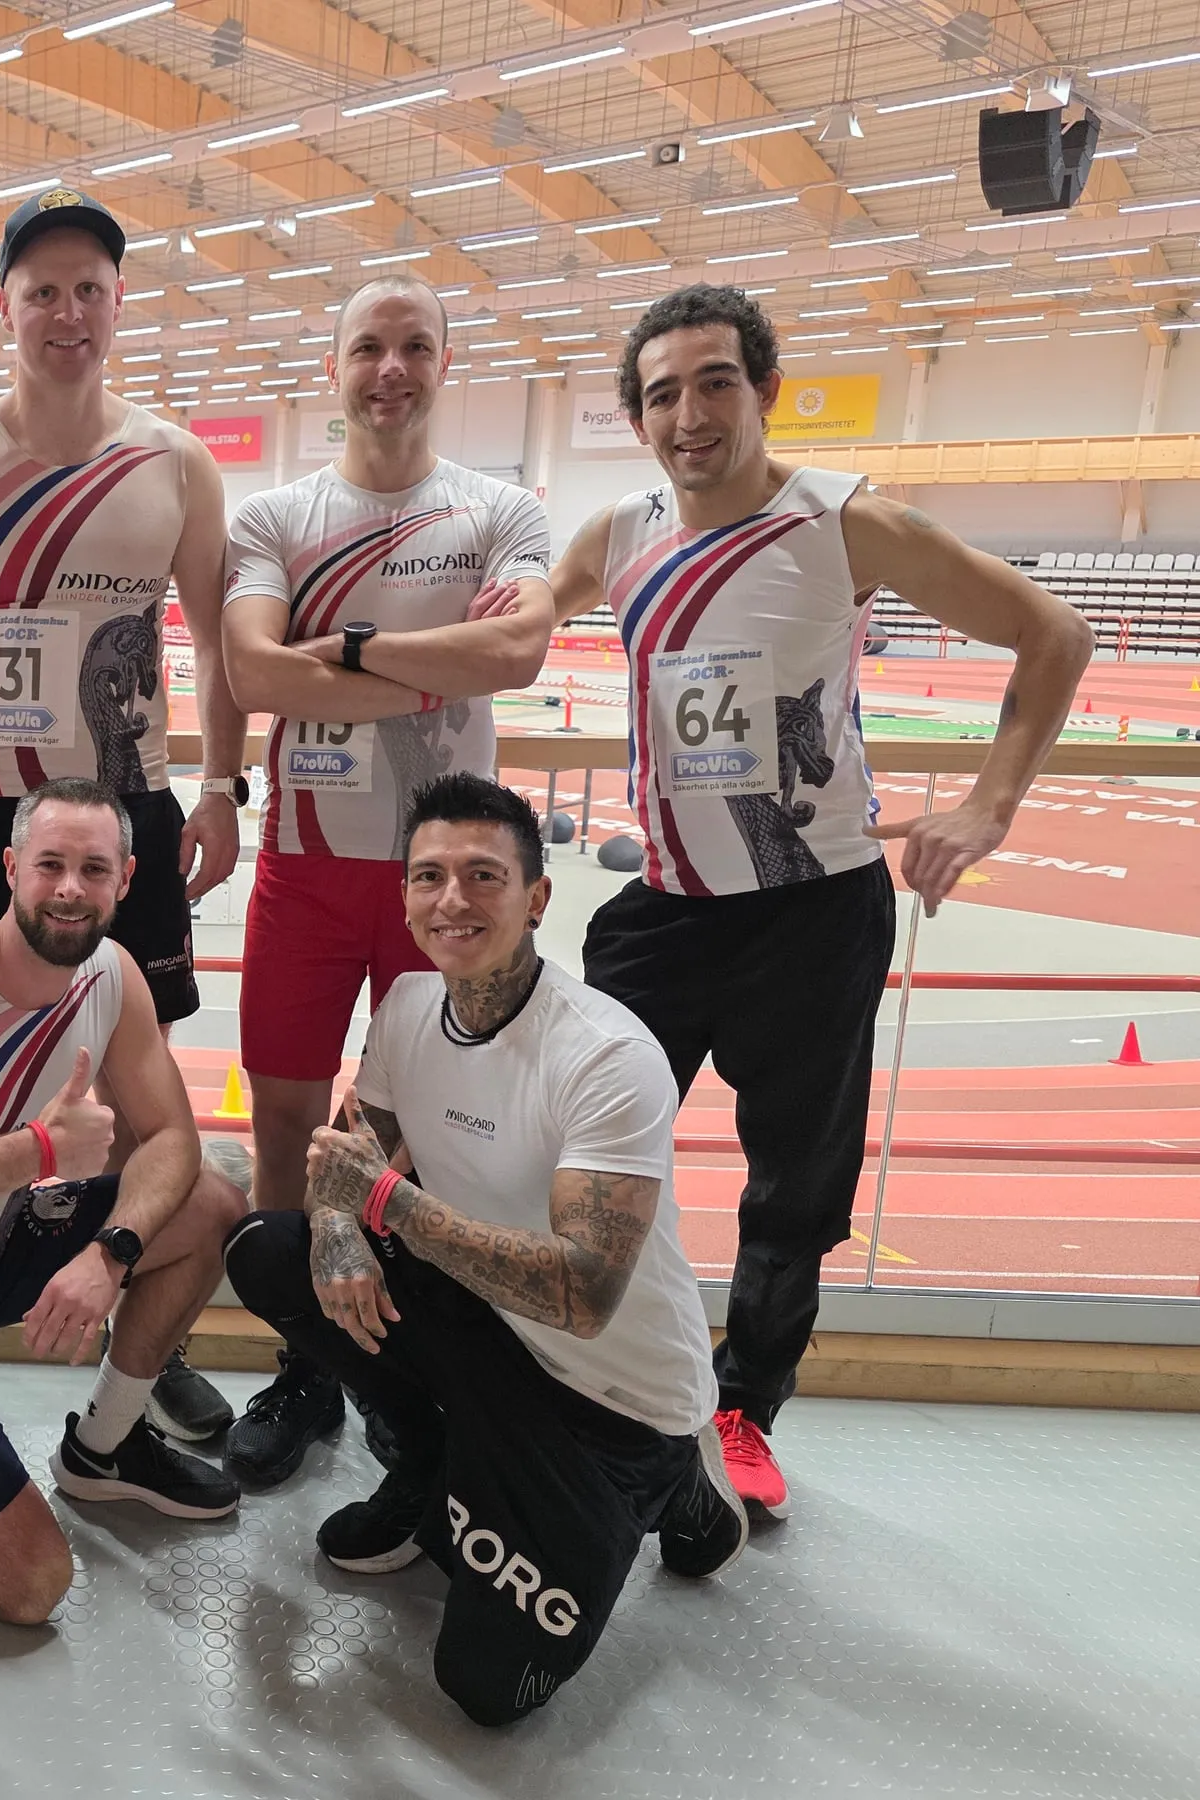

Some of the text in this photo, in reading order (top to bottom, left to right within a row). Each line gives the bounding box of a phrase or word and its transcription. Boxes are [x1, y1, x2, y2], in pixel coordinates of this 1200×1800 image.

[380, 553, 482, 576] MIDGARD
[22, 615, 68, 626] inomhus
[0, 628, 44, 640] -OCR-
[656, 650, 762, 667] Karlstad inomhus
[683, 665, 734, 680] -OCR-
[676, 685, 750, 746] 64
[24, 735, 37, 743] alla
[38, 735, 59, 745] vägar
[293, 754, 341, 770] ProVia
[677, 755, 741, 775] ProVia
[672, 783, 708, 791] Säkerhet
[722, 781, 737, 789] alla
[740, 779, 765, 789] vägar
[986, 851, 1128, 879] ENA
[445, 1108, 495, 1132] MIDGARD
